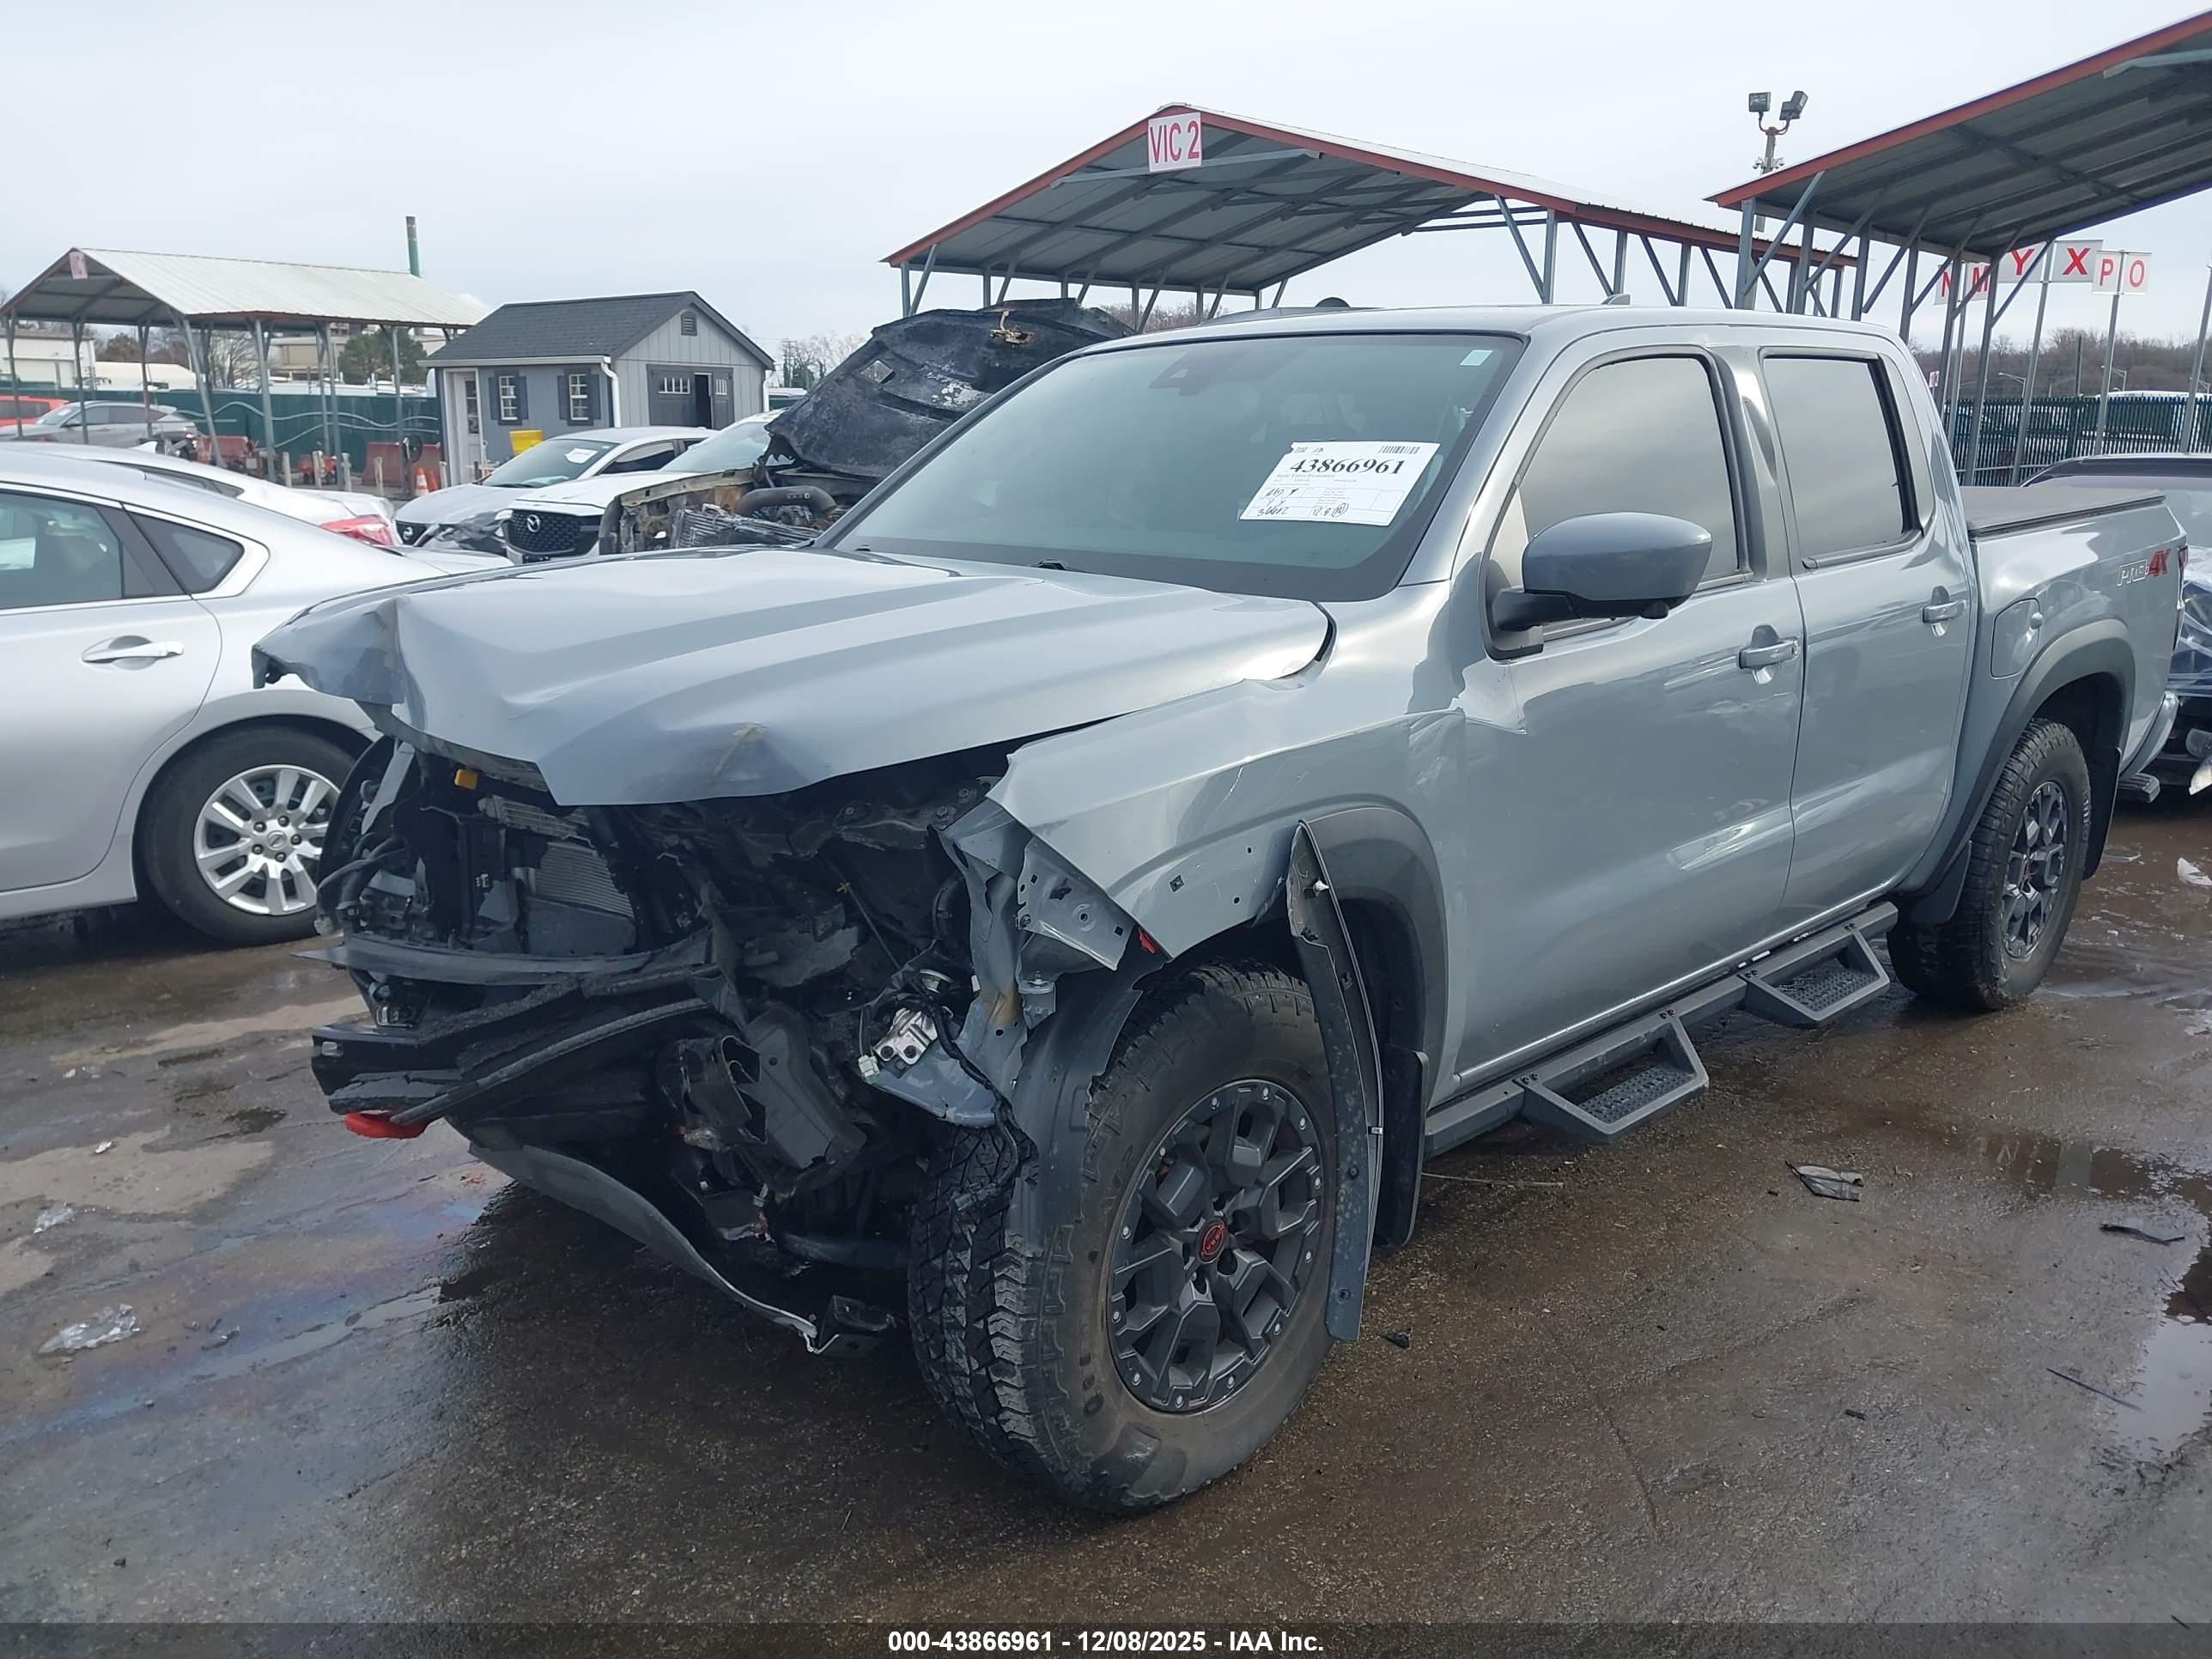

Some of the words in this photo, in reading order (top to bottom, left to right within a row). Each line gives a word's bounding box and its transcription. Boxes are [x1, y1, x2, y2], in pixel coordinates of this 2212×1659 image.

[1149, 122, 1182, 164] VIC
[1187, 120, 1200, 160] 2
[2009, 247, 2035, 276] Y
[2062, 247, 2092, 276] X
[2100, 258, 2114, 286] P
[2129, 259, 2145, 288] O
[1289, 458, 1407, 474] 43866961
